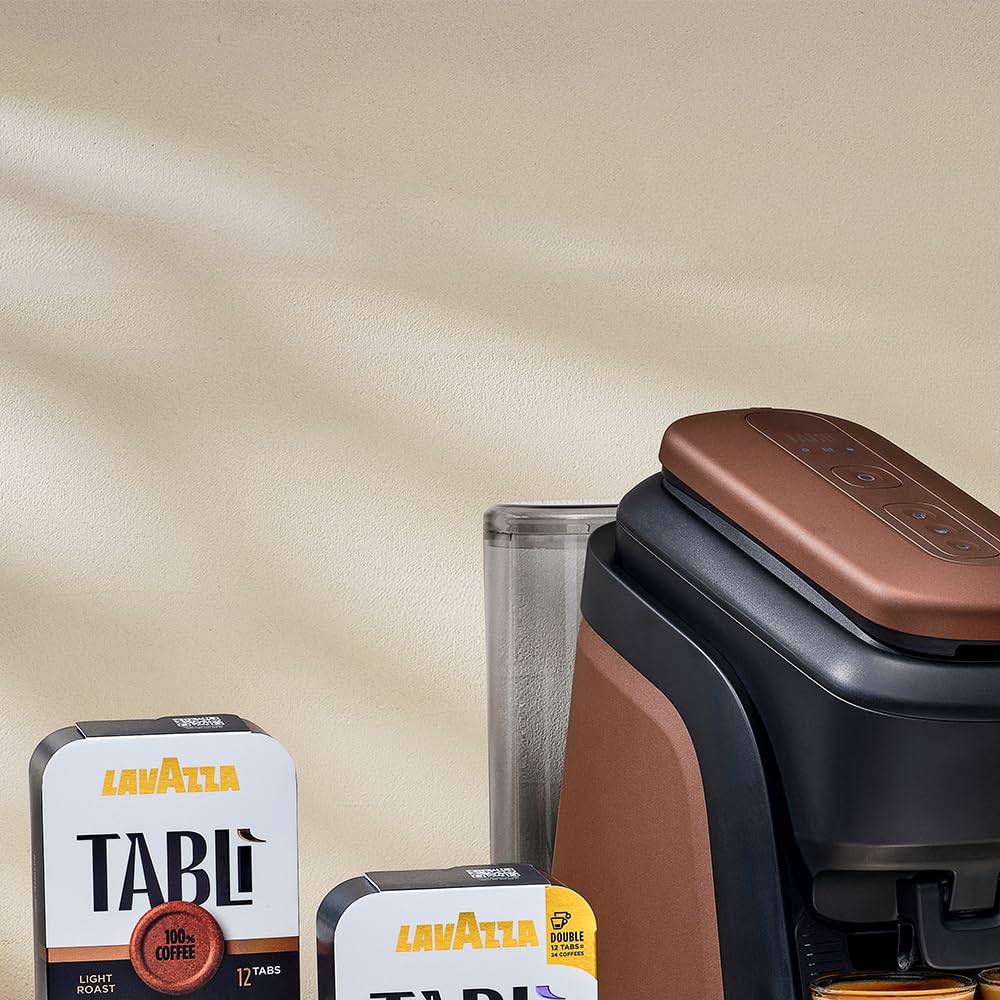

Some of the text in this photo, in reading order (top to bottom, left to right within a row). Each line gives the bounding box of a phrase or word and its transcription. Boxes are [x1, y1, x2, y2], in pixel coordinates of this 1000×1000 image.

[101, 757, 240, 796] LAVAZZA
[164, 928, 195, 944] 100%
[395, 911, 539, 953] LAVAZZA
[551, 931, 584, 943] DOUBLE
[155, 945, 196, 961] COFFEE
[79, 974, 112, 983] LIGHT
[237, 966, 281, 987] 12 TABS
[77, 984, 116, 994] ROAST
